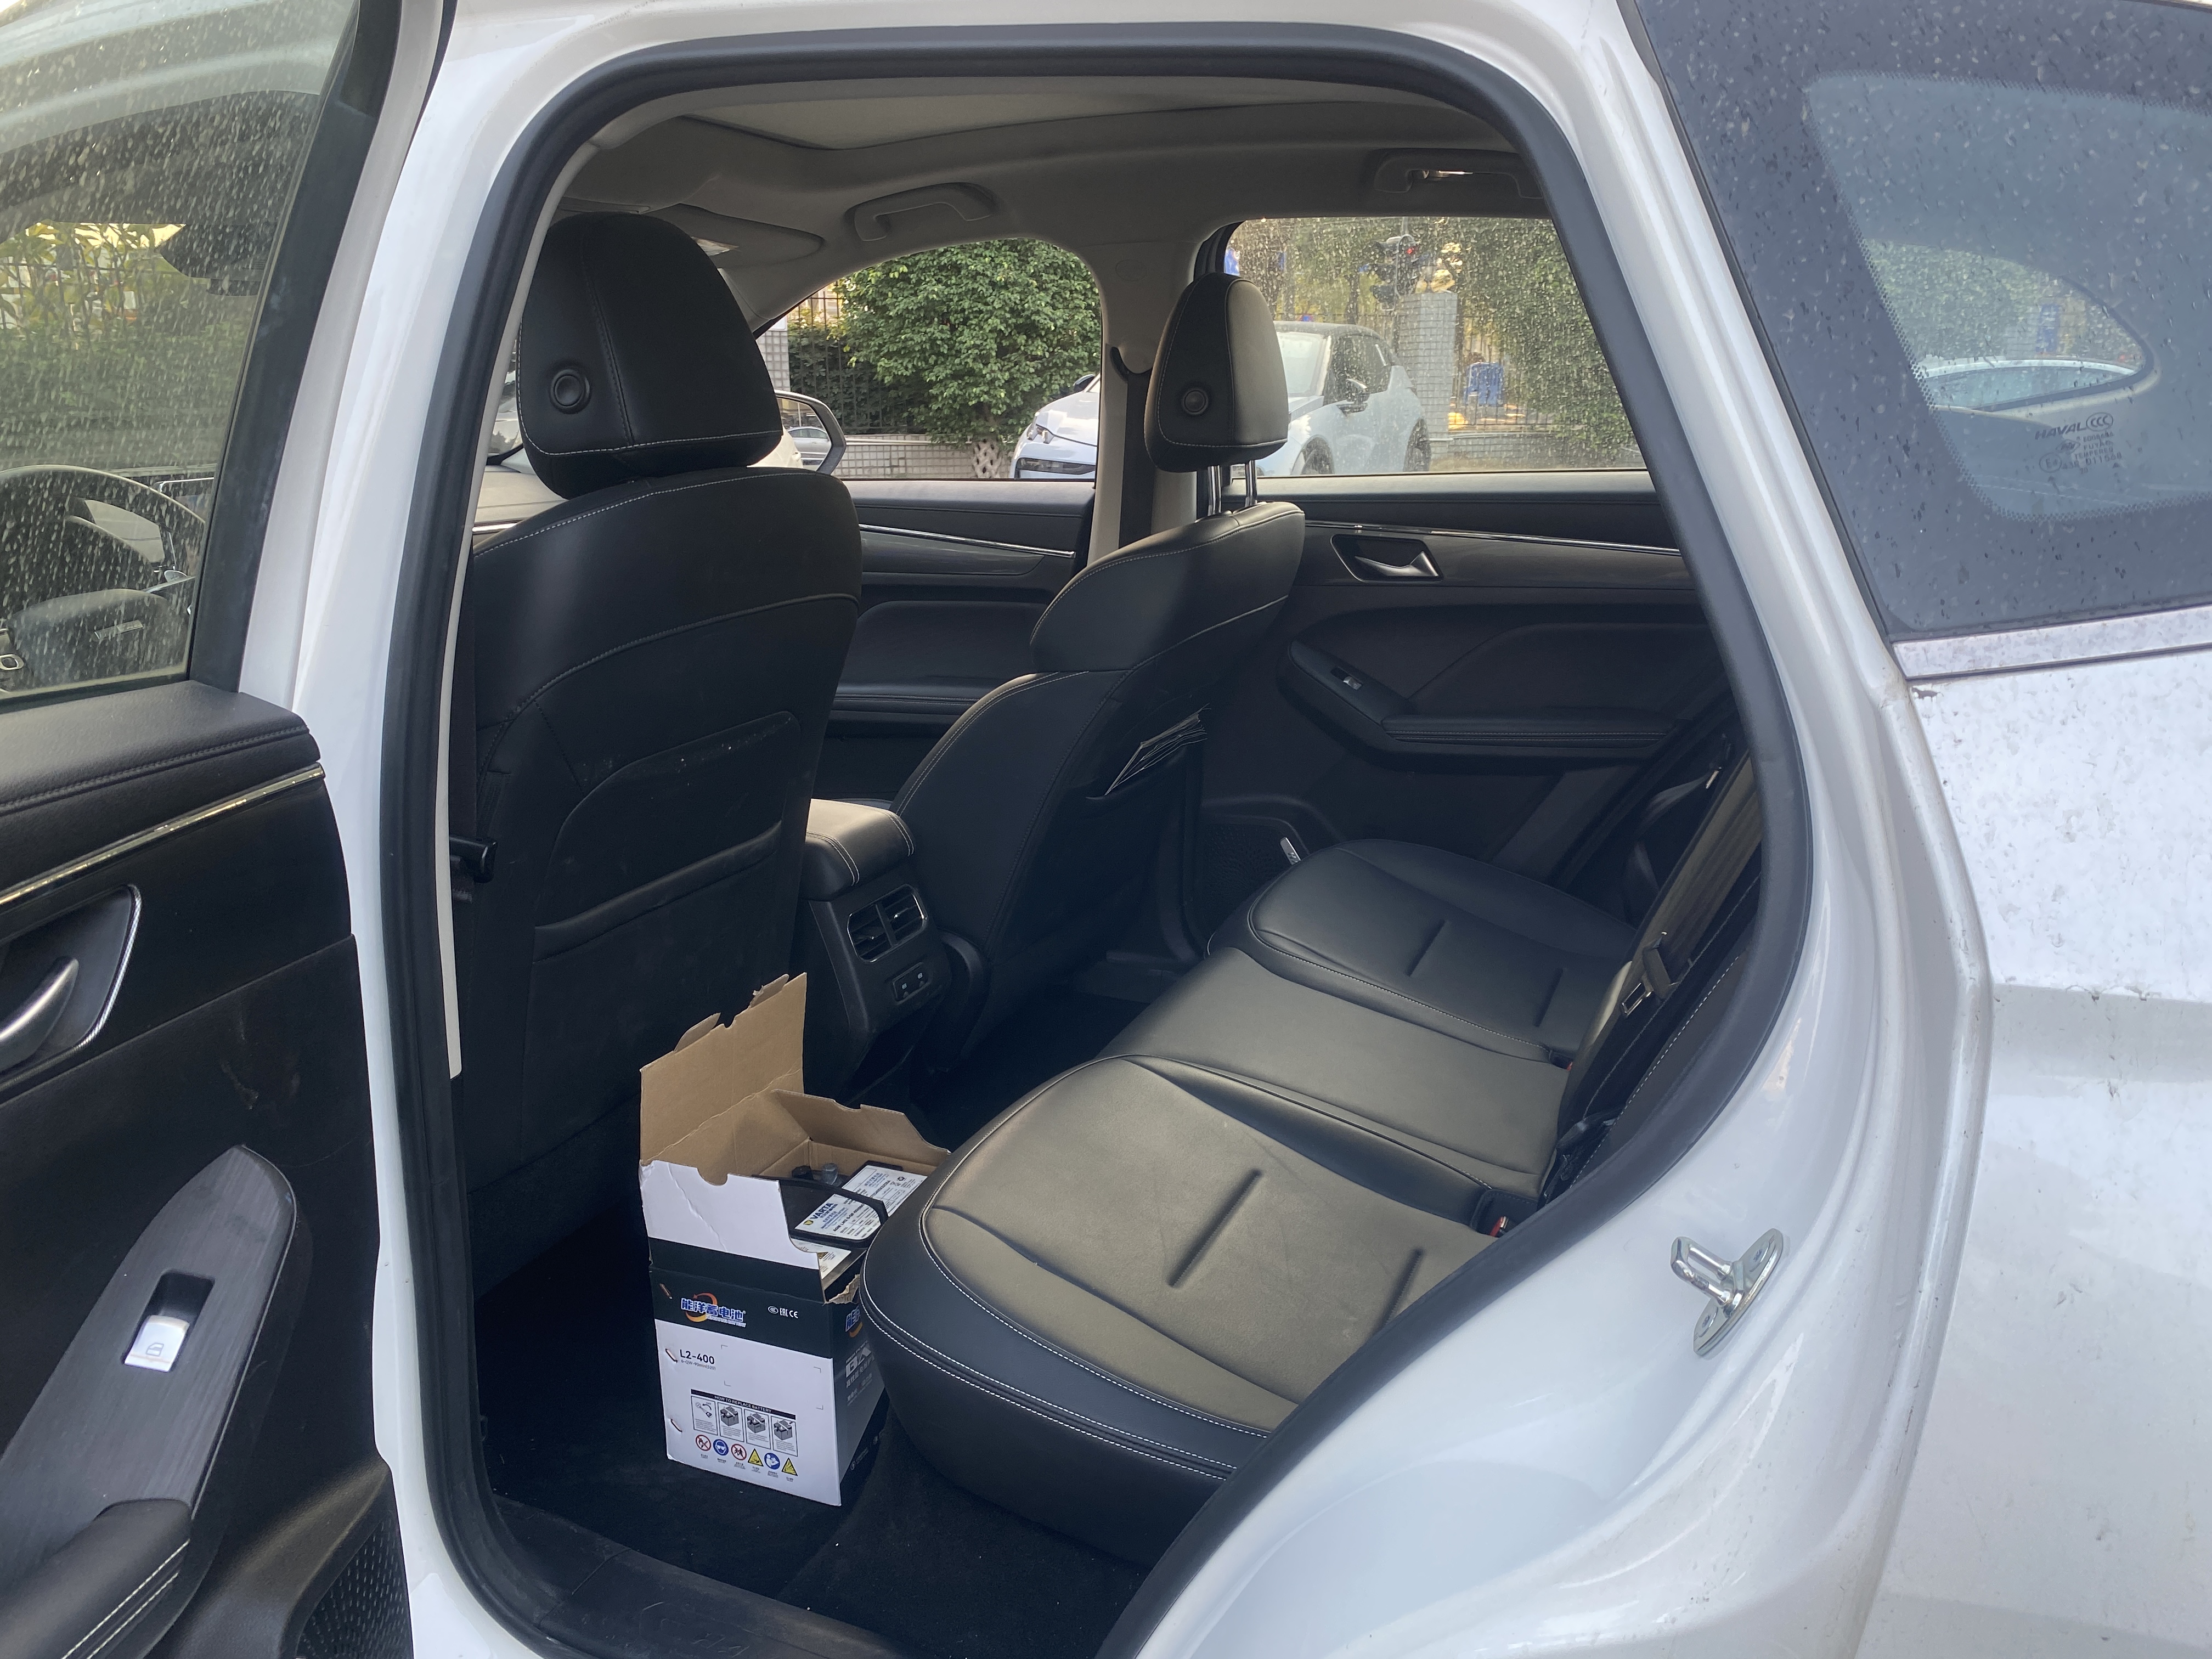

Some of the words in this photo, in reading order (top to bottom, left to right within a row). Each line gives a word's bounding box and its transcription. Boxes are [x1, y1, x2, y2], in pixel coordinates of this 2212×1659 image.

[2035, 422, 2086, 439] HAVAL
[810, 1203, 834, 1219] VARTA
[681, 1298, 743, 1322] 能洋蓄电池
[680, 1349, 715, 1364] L2-400
[732, 1400, 752, 1408] REPLACE
[752, 1404, 772, 1413] BATTERY
